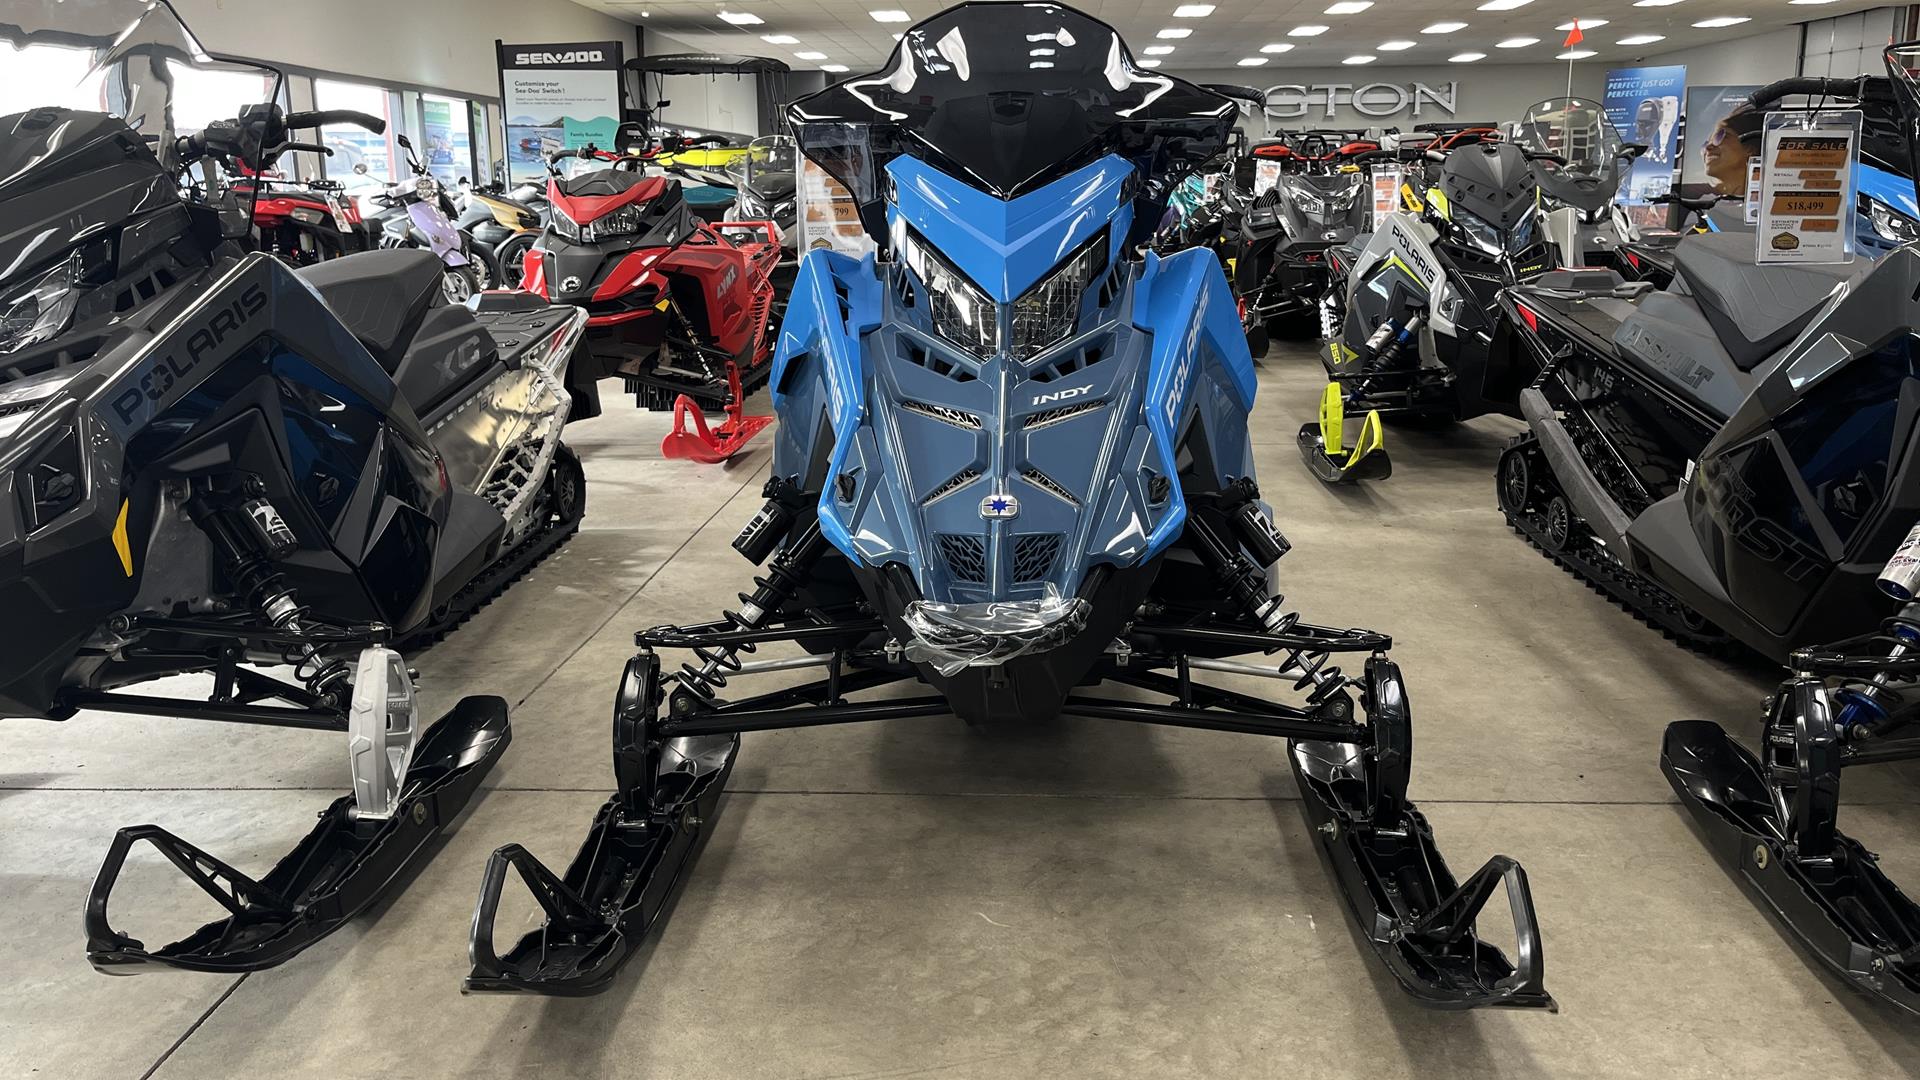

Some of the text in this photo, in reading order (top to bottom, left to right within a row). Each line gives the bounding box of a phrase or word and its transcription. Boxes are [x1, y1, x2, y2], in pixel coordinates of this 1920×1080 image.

[1607, 79, 1674, 90] PERFECT JUST GOT
[1778, 141, 1847, 151] FOR SALE
[1787, 201, 1825, 211] $18,499
[1391, 224, 1437, 284] POLARIS
[1519, 264, 1543, 273] INDY
[717, 264, 736, 300] LYNX
[111, 282, 268, 426] POLARIS
[433, 335, 480, 380] XC
[1165, 282, 1209, 429] POLARIS
[1329, 342, 1342, 365] 850
[1620, 322, 1715, 390] ASSAULT
[1593, 366, 1615, 390] 146
[1031, 383, 1094, 406] INDY
